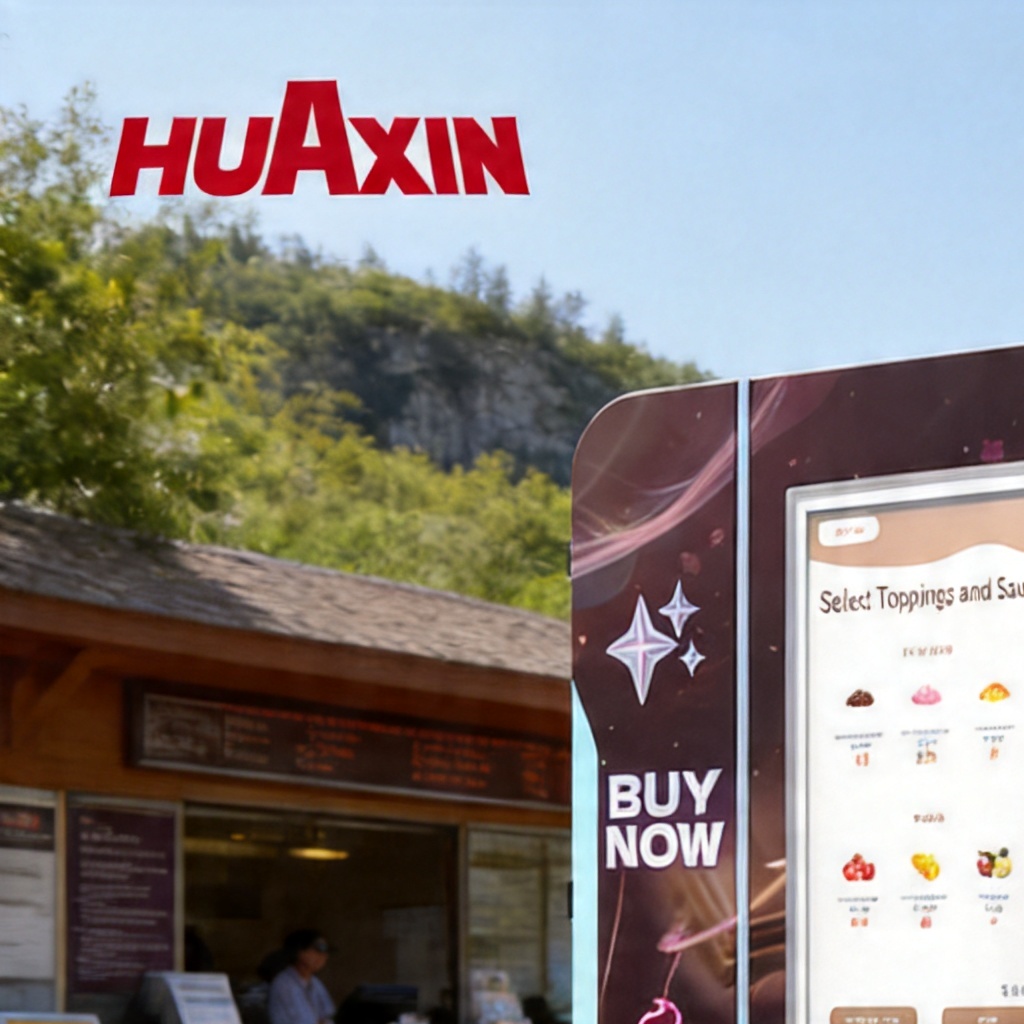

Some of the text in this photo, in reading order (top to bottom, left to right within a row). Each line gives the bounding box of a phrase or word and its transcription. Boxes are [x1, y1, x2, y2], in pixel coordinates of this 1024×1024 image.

[820, 588, 872, 614] Select
[876, 584, 954, 613] Toppings
[959, 578, 992, 602] and
[608, 768, 723, 820] BUY
[605, 821, 725, 869] NOW
